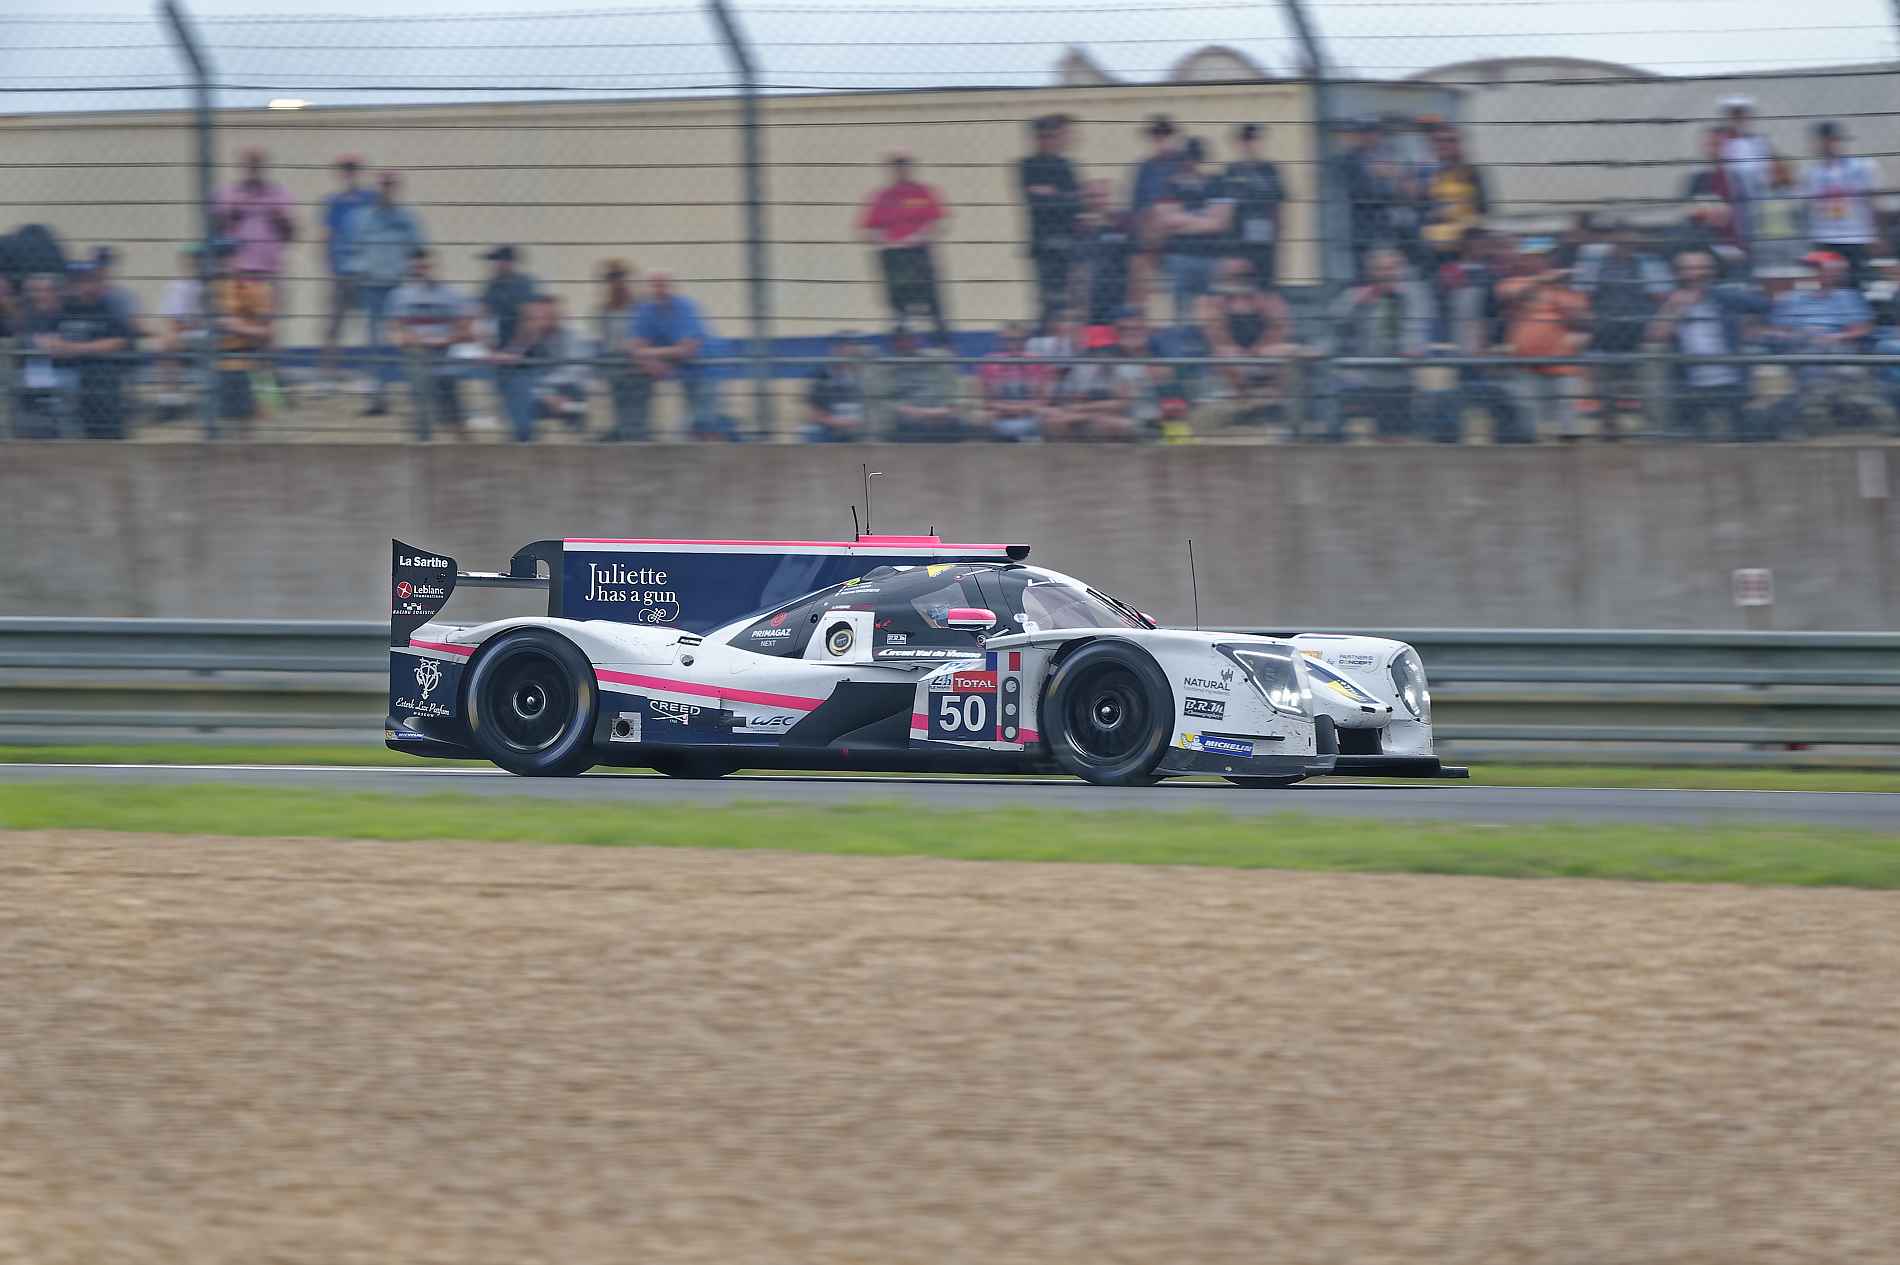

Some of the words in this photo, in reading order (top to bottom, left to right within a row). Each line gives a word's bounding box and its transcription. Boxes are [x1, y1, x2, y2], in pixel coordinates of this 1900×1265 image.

[399, 555, 412, 566] La
[413, 556, 448, 568] Sarthe
[585, 563, 668, 601] Juliette
[413, 585, 444, 595] Leblanc
[597, 585, 627, 602] has
[630, 590, 640, 602] a
[643, 590, 677, 606] gun
[751, 629, 792, 637] PRIMAGAZ
[955, 678, 996, 688] TOTAL
[1184, 677, 1231, 691] NATURAL
[649, 701, 701, 715] CREED
[940, 695, 986, 732] 50
[751, 716, 795, 726] WEC
[1205, 741, 1252, 752] MICHELIN
